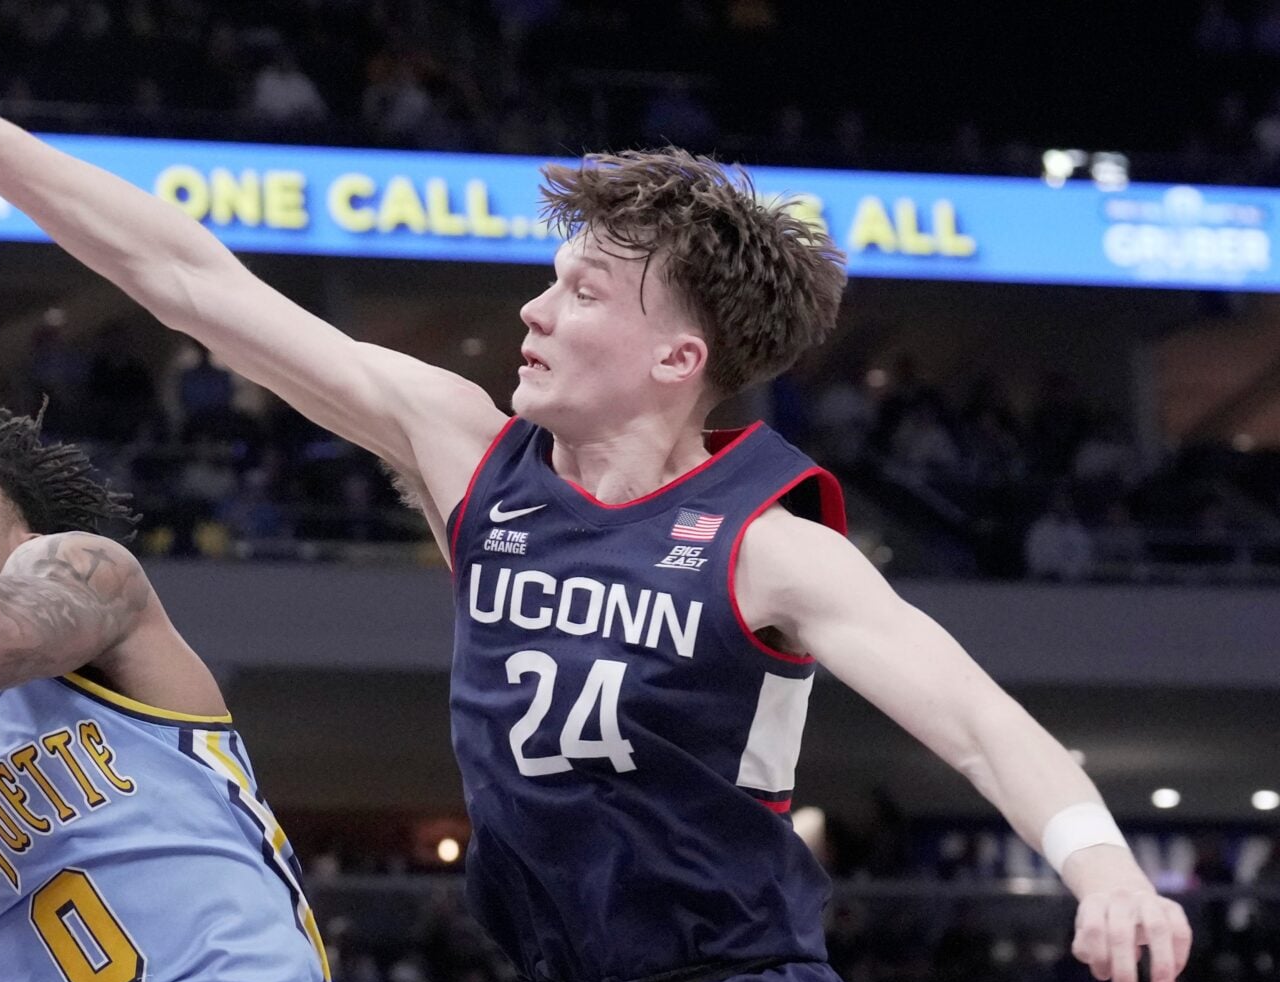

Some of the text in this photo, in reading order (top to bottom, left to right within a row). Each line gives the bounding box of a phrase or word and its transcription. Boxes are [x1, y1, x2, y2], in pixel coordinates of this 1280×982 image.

[155, 164, 309, 230] ONE
[848, 195, 977, 257] ALL
[483, 538, 527, 555] CHANGE
[489, 528, 529, 543] BE THE
[669, 545, 705, 557] BIG
[660, 555, 709, 568] EAST
[469, 562, 704, 659] UCONN
[504, 649, 638, 778] 24
